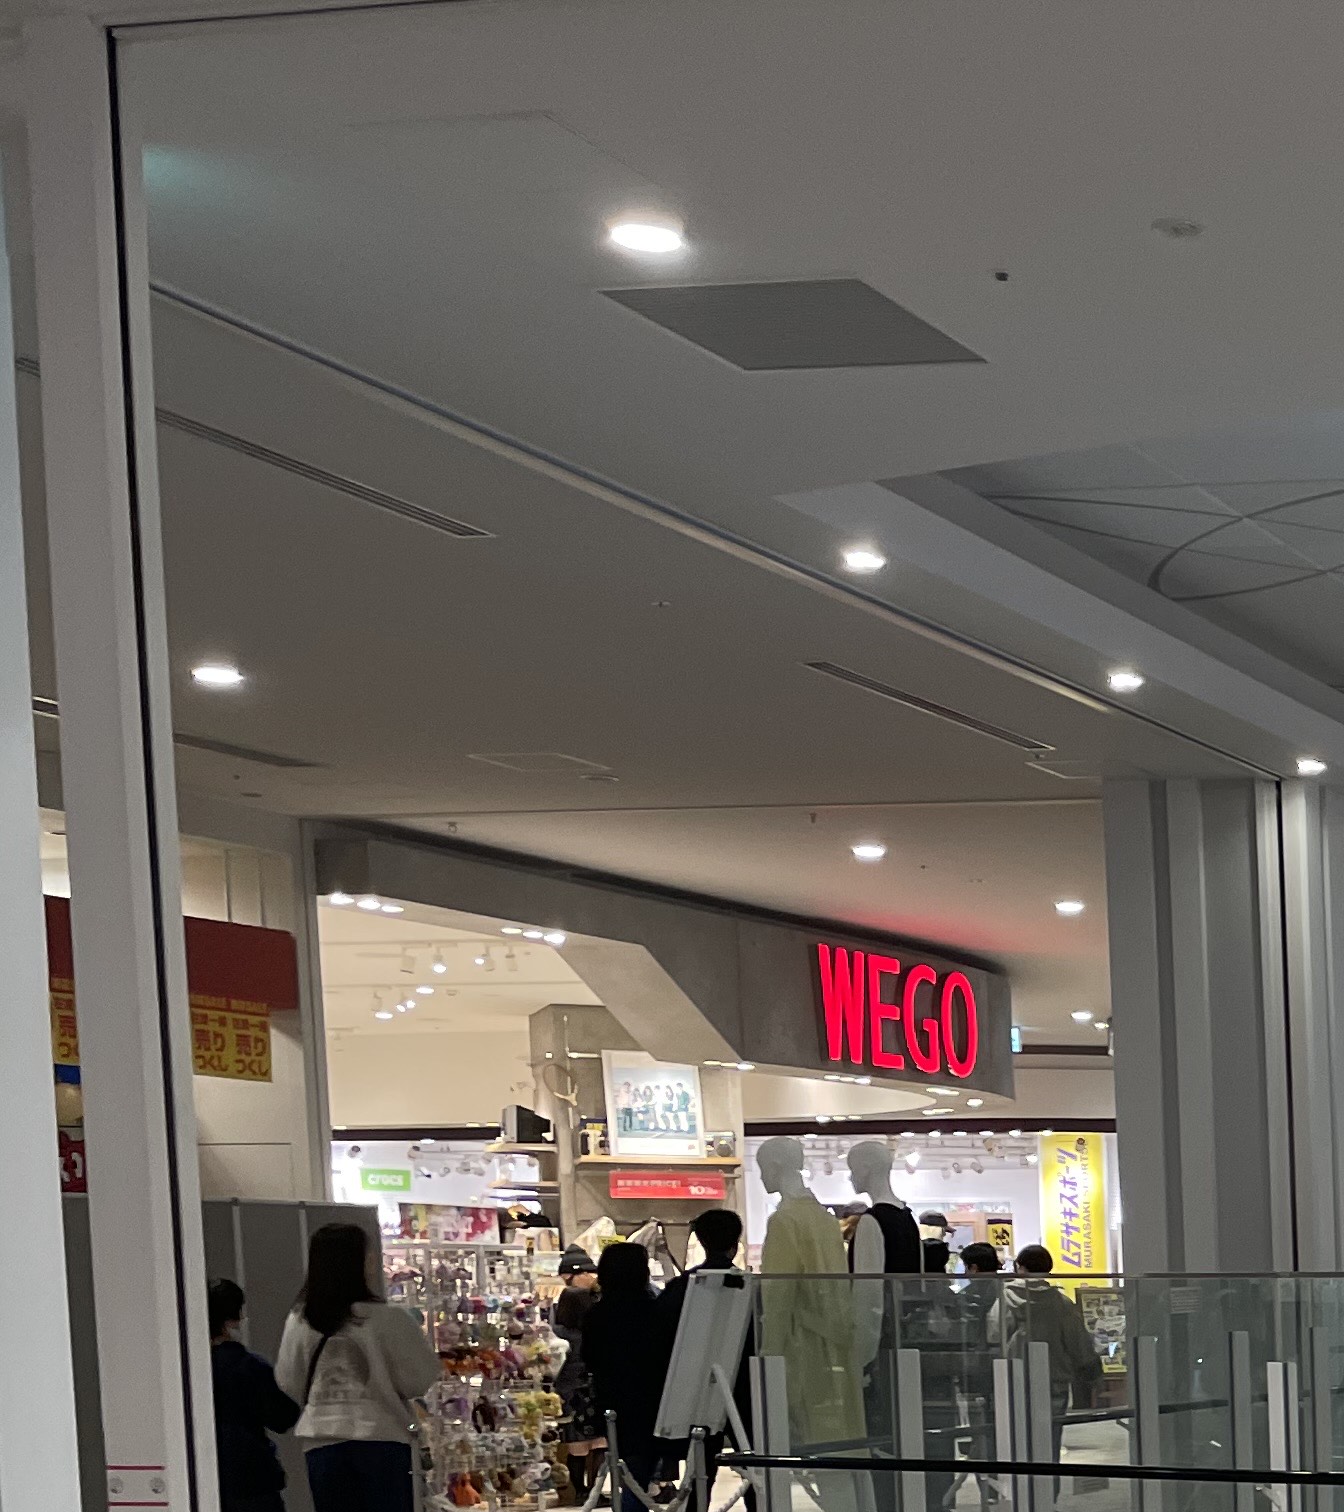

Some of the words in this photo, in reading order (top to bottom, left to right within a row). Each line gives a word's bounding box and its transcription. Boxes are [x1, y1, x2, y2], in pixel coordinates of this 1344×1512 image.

[818, 942, 978, 1078] WEGO
[367, 1173, 404, 1187] crocs
[1056, 1147, 1083, 1269] ムラサキスポーツ
[1082, 1200, 1094, 1269] MURASAKI
